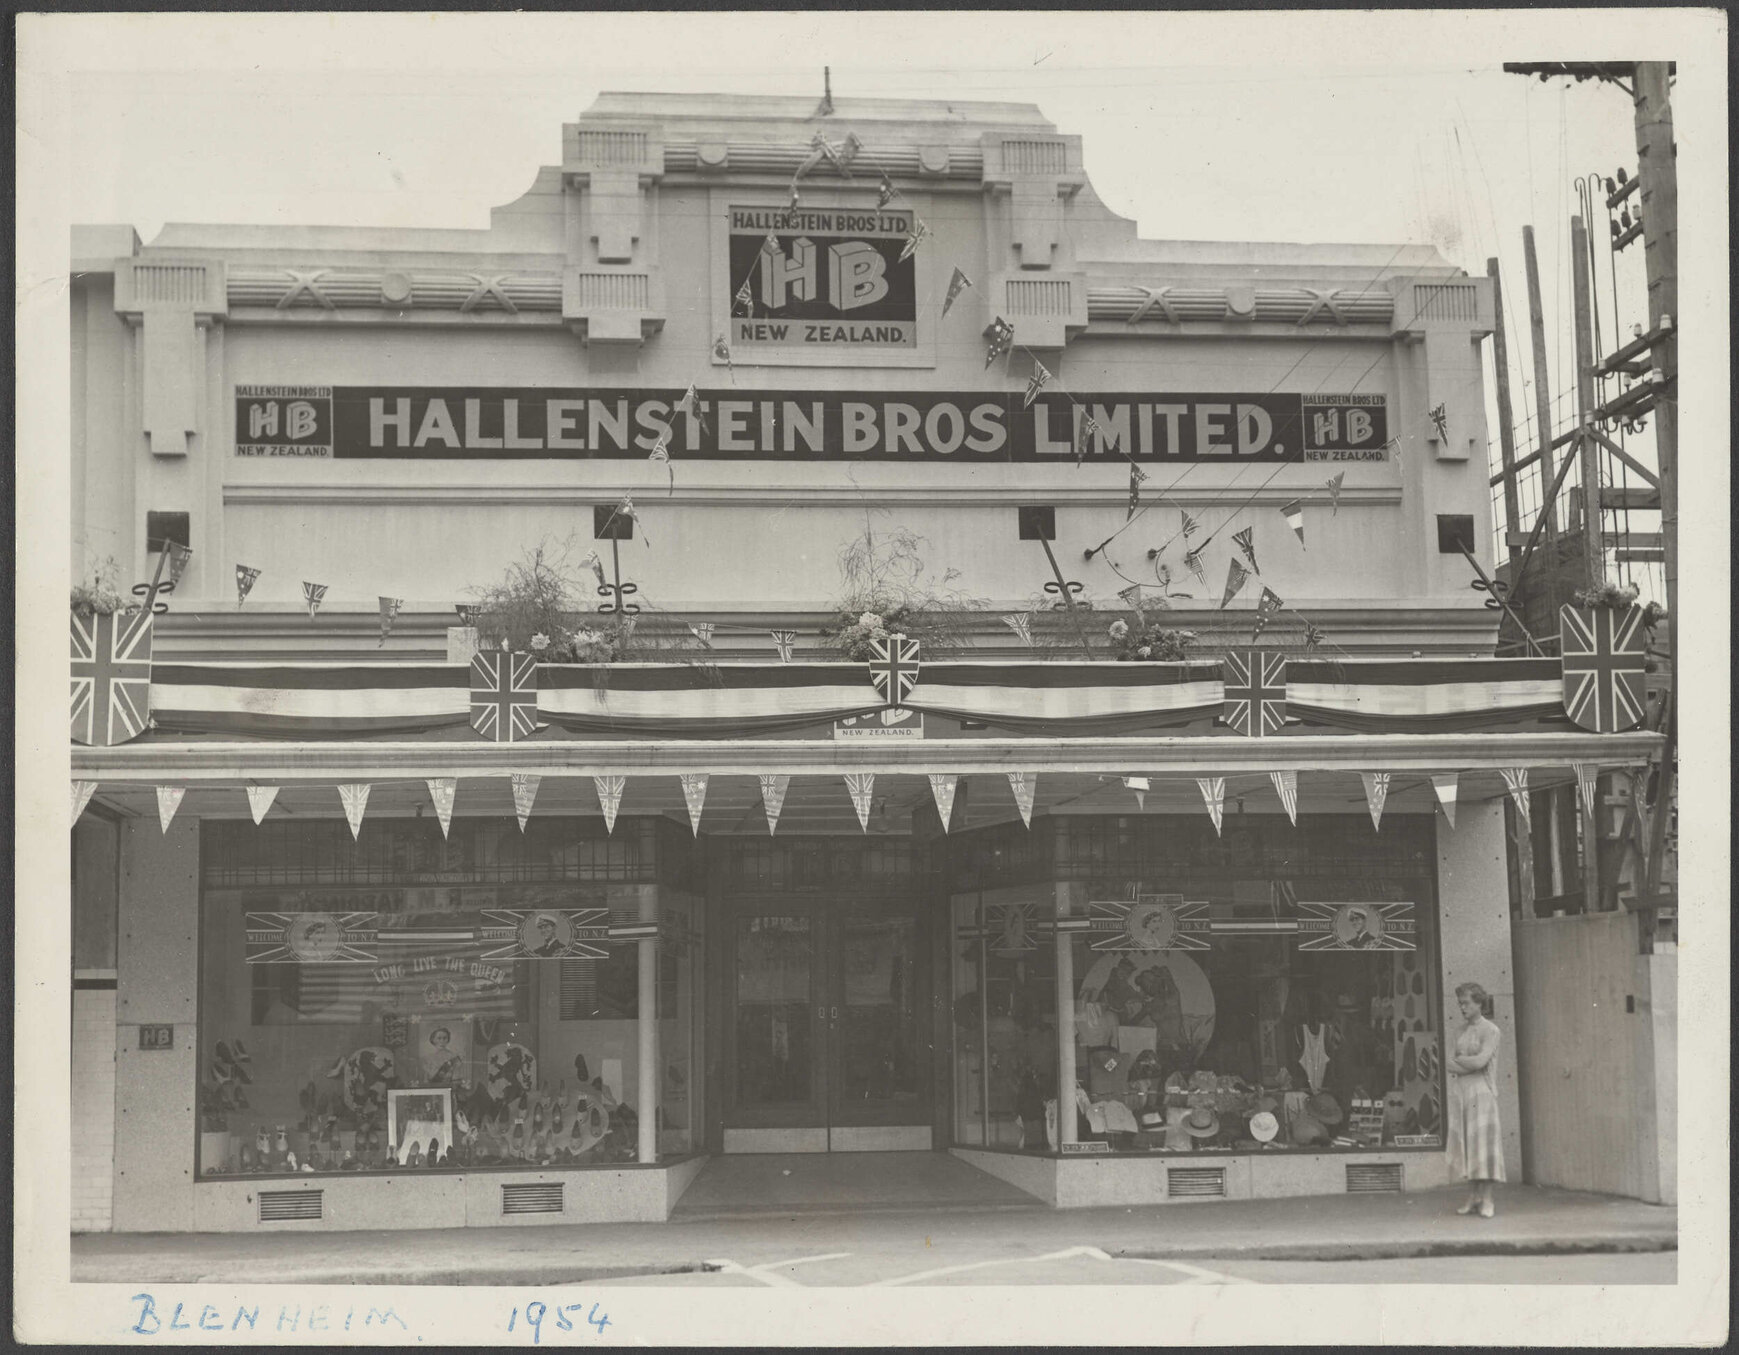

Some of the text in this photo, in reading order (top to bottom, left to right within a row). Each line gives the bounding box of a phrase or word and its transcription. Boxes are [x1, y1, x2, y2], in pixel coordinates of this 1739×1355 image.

[733, 211, 910, 234] HALLENSTEIN BROS LTD.
[741, 324, 907, 344] NEW ZEALAND.
[236, 386, 298, 397] HALLENSTEIN
[299, 386, 317, 397] BROS
[1303, 394, 1351, 405] HALLENSTEIN
[1352, 395, 1371, 405] BROS
[369, 397, 1285, 455] HALLENSTEIN BROS LIMITED.
[237, 446, 266, 456] NEW
[1306, 451, 1385, 461] NEW ZEALAND.
[1091, 921, 1125, 930] WELCOME
[1300, 921, 1331, 930] WELCOME
[248, 932, 284, 942] WELCOME
[482, 929, 517, 939] WELCOME
[372, 956, 506, 984] LONG LIVE THE QUEEN
[507, 1301, 613, 1344] 1954
